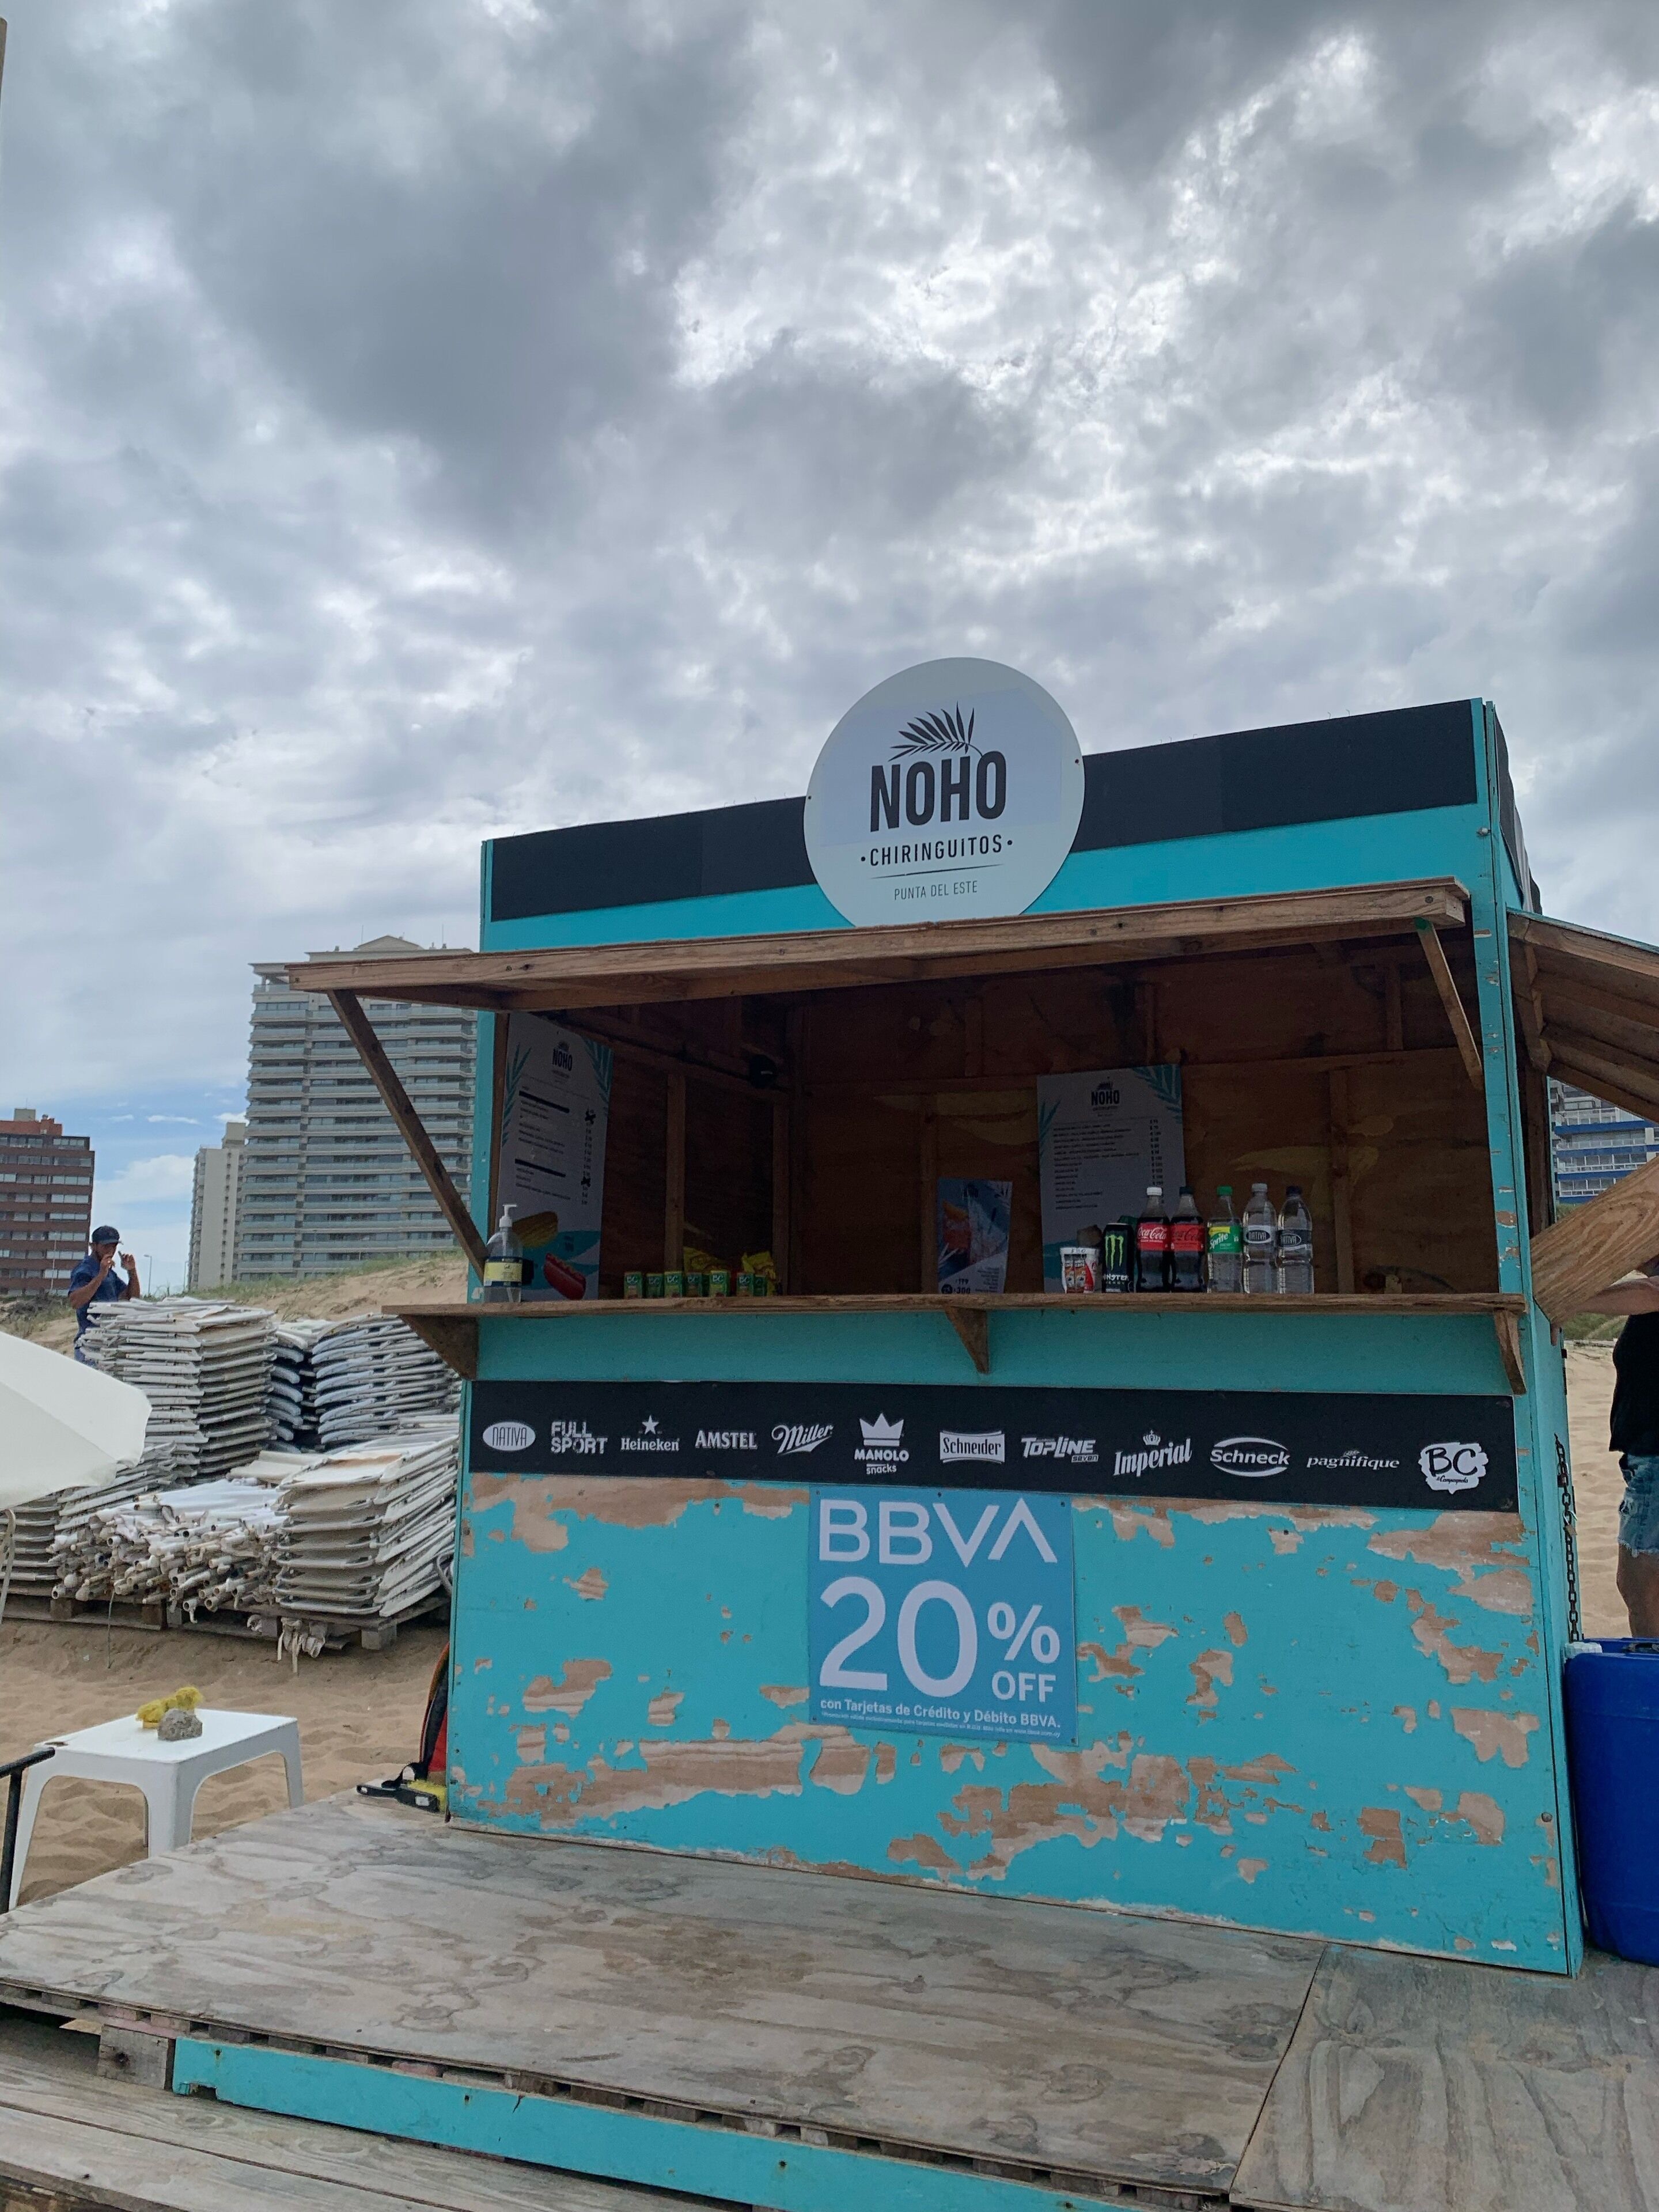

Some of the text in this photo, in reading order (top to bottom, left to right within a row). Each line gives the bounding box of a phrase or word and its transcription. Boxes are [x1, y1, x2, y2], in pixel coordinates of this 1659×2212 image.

[870, 751, 1006, 832] NOHO
[870, 834, 1002, 866] CHIRINGUITOS
[895, 880, 978, 900] PUNTA DEL ESTE
[552, 1048, 573, 1072] NOHO
[1091, 1089, 1120, 1106] NOHO
[1210, 1232, 1229, 1249] Sprite
[1248, 1232, 1267, 1240] NATIVA
[493, 1426, 528, 1449] NATIVA
[551, 1421, 592, 1438] FULL
[771, 1424, 834, 1455] Miller
[551, 1437, 608, 1455] SPORT
[620, 1437, 680, 1452] Heineken
[695, 1430, 758, 1450] AMSTEL
[942, 1437, 1002, 1457] Schneider
[854, 1448, 909, 1463] MANOLO
[1073, 1455, 1099, 1463] seven
[1113, 1438, 1193, 1477] Imperial
[1210, 1448, 1290, 1466] Schneck
[1306, 1455, 1400, 1471] pagnifique
[1425, 1447, 1478, 1478] BC
[866, 1463, 897, 1475] snacks
[819, 1497, 1058, 1568] BBVA
[820, 1576, 1060, 1698] 20%
[991, 1670, 1056, 1703] OFF
[820, 1699, 842, 1710] con
[844, 1699, 892, 1714] Tarjetas
[895, 1703, 910, 1715] de
[914, 1705, 960, 1720] Crédito
[963, 1711, 971, 1723] y
[974, 1709, 1017, 1724] Débito
[1020, 1713, 1060, 1728] BBVA.
